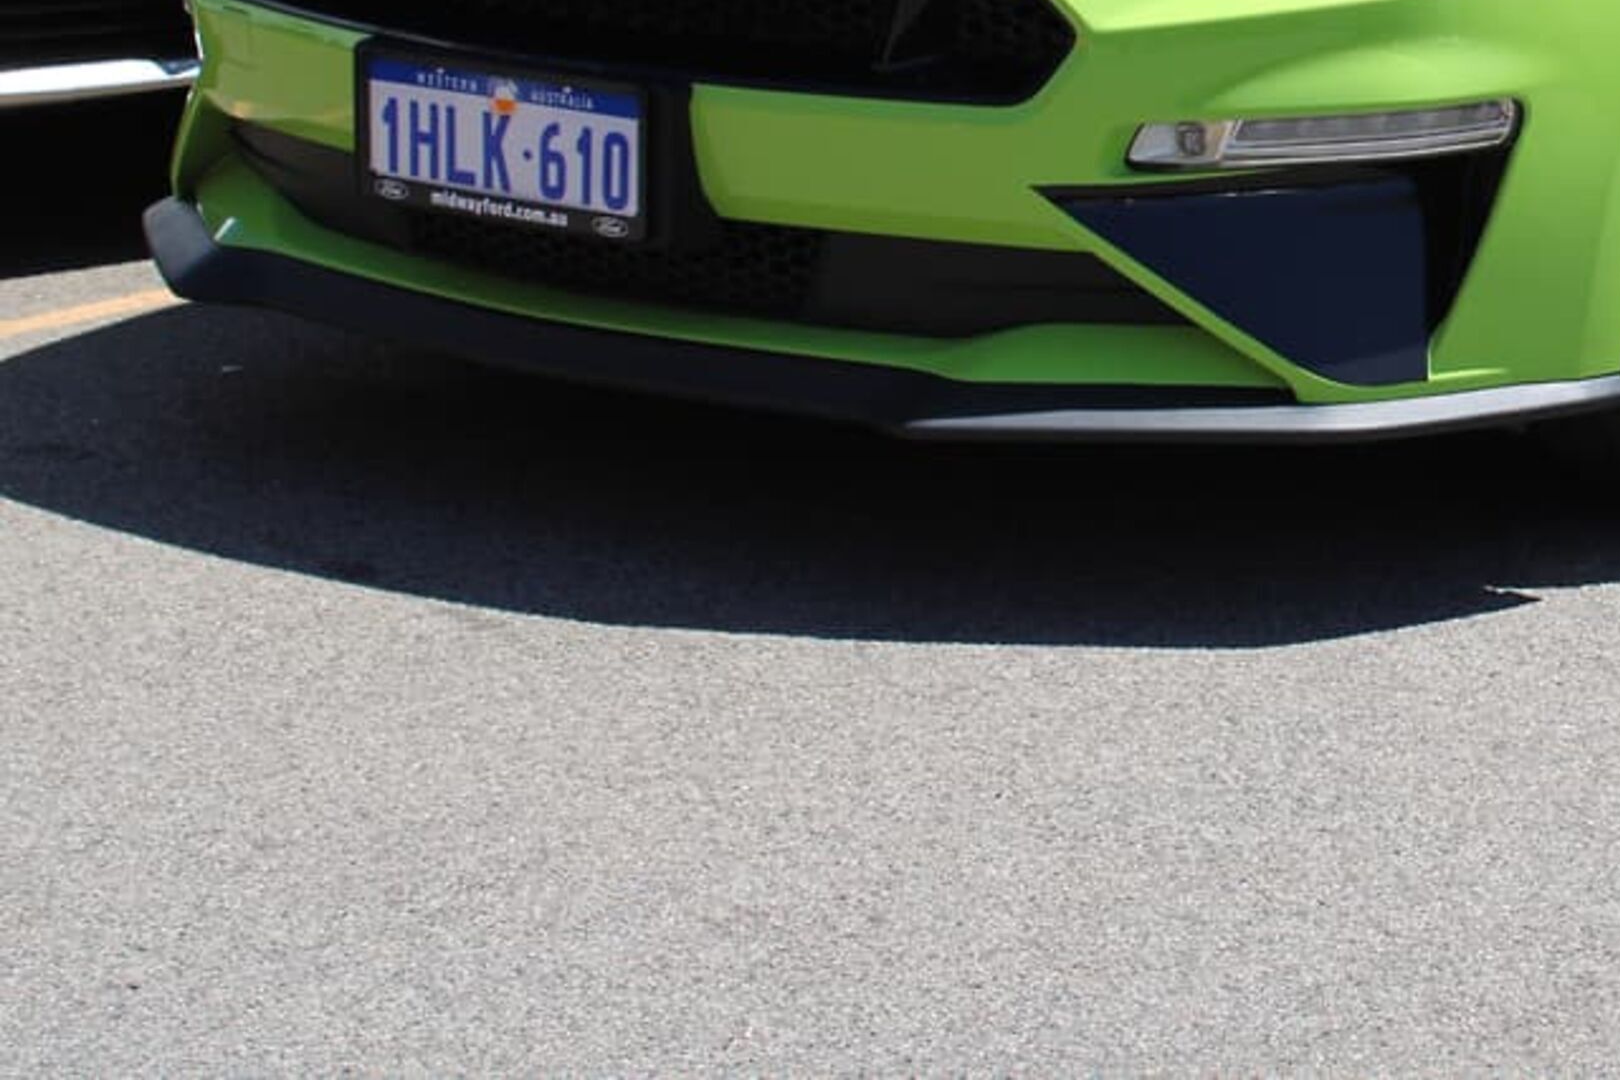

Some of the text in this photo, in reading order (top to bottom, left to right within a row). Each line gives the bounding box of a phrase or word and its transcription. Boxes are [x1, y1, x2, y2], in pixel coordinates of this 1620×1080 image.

[416, 71, 595, 110] WESTERN AUSTRALIA
[430, 190, 569, 227] midwayford.com.au
